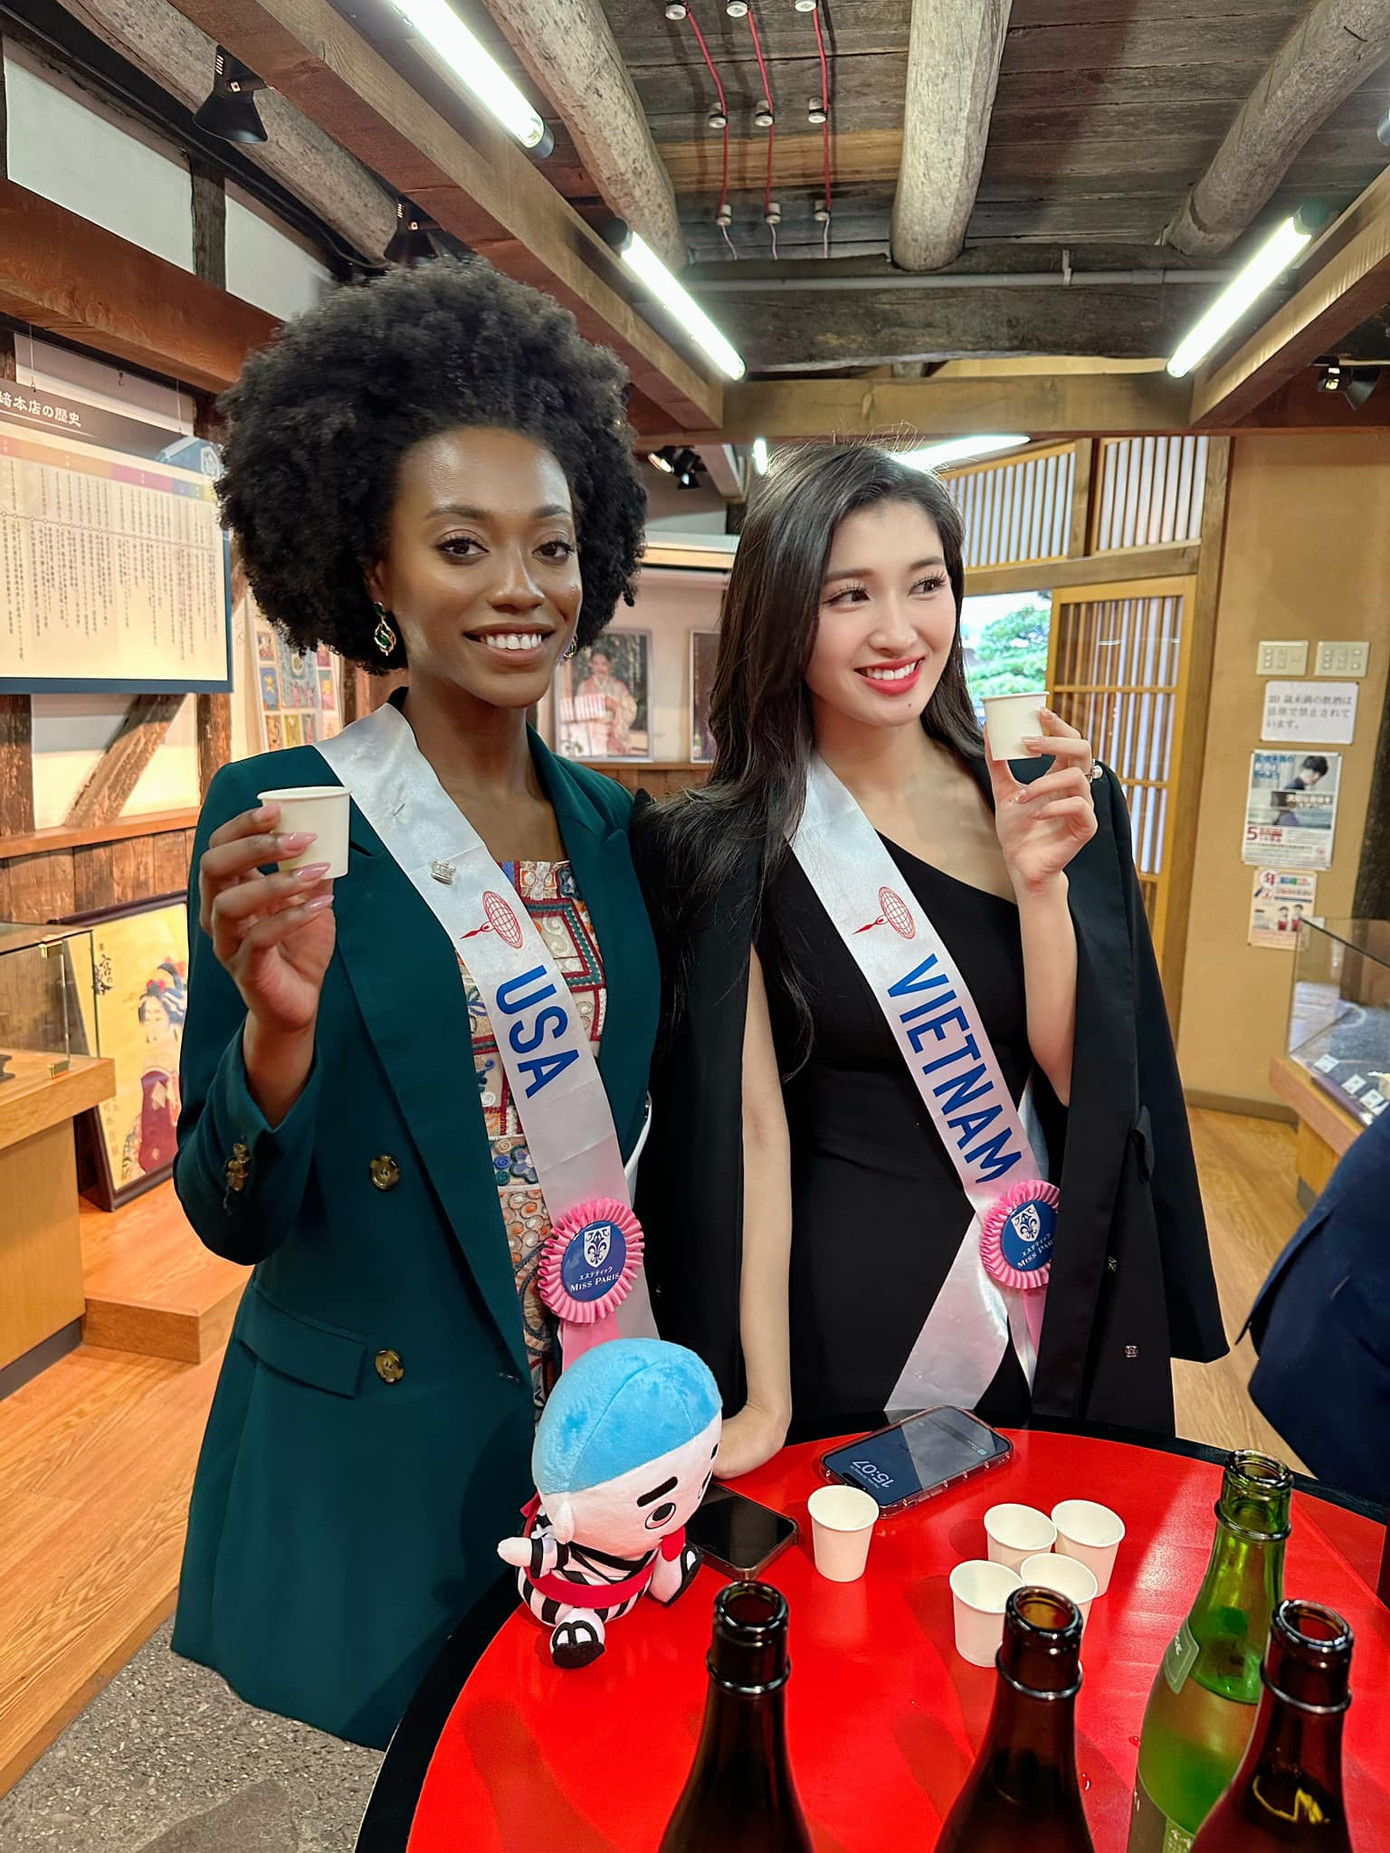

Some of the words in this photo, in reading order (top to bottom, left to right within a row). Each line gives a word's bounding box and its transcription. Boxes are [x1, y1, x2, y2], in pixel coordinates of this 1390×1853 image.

[496, 965, 579, 1099] USA
[887, 952, 1022, 1184] VIETNAM
[852, 1461, 894, 1488] 15:07
